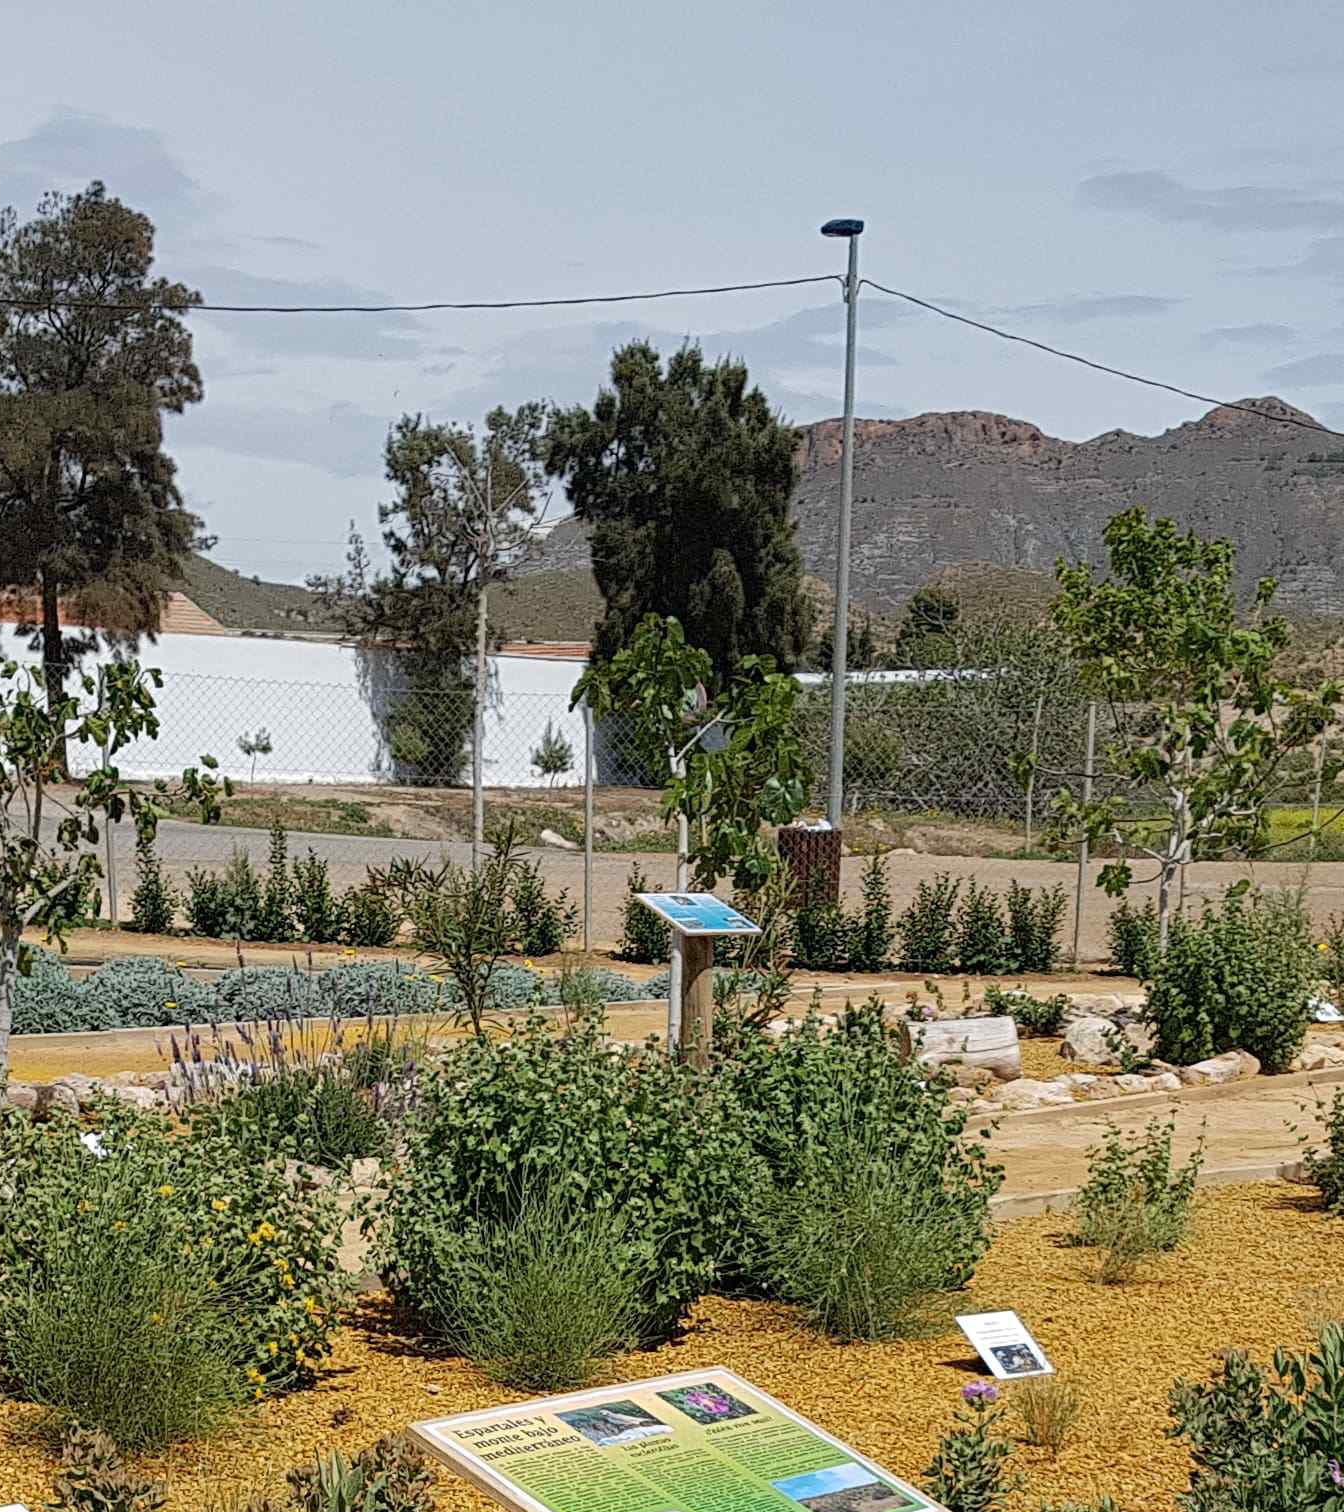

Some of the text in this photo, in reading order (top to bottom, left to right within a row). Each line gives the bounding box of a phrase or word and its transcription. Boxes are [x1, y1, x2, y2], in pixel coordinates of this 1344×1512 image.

[452, 1415, 547, 1440] Espartales y
[472, 1425, 559, 1449] monte bajo
[479, 1435, 581, 1461] mediterráneo
